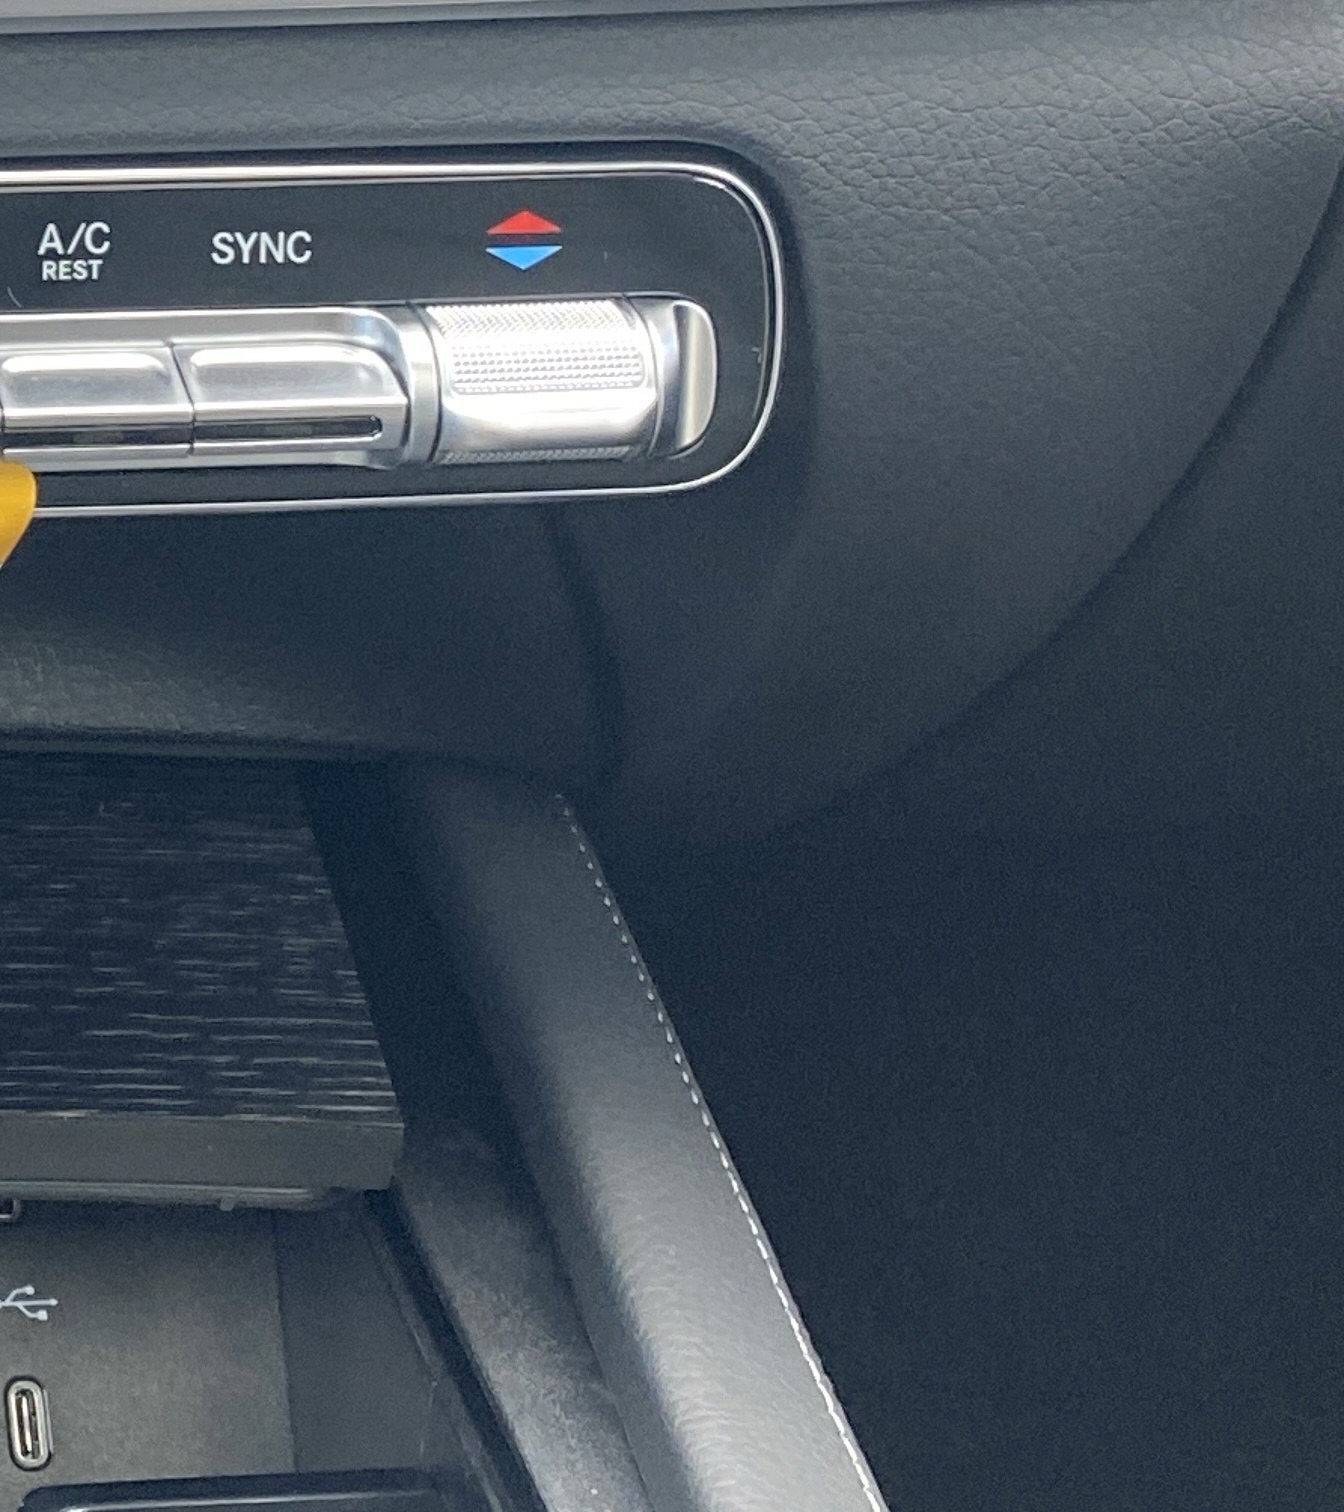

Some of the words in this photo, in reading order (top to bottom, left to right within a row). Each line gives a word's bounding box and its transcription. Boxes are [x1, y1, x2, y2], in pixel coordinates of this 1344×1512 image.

[38, 222, 110, 257] A/C
[211, 230, 312, 265] SYNC
[42, 259, 103, 281] REST
